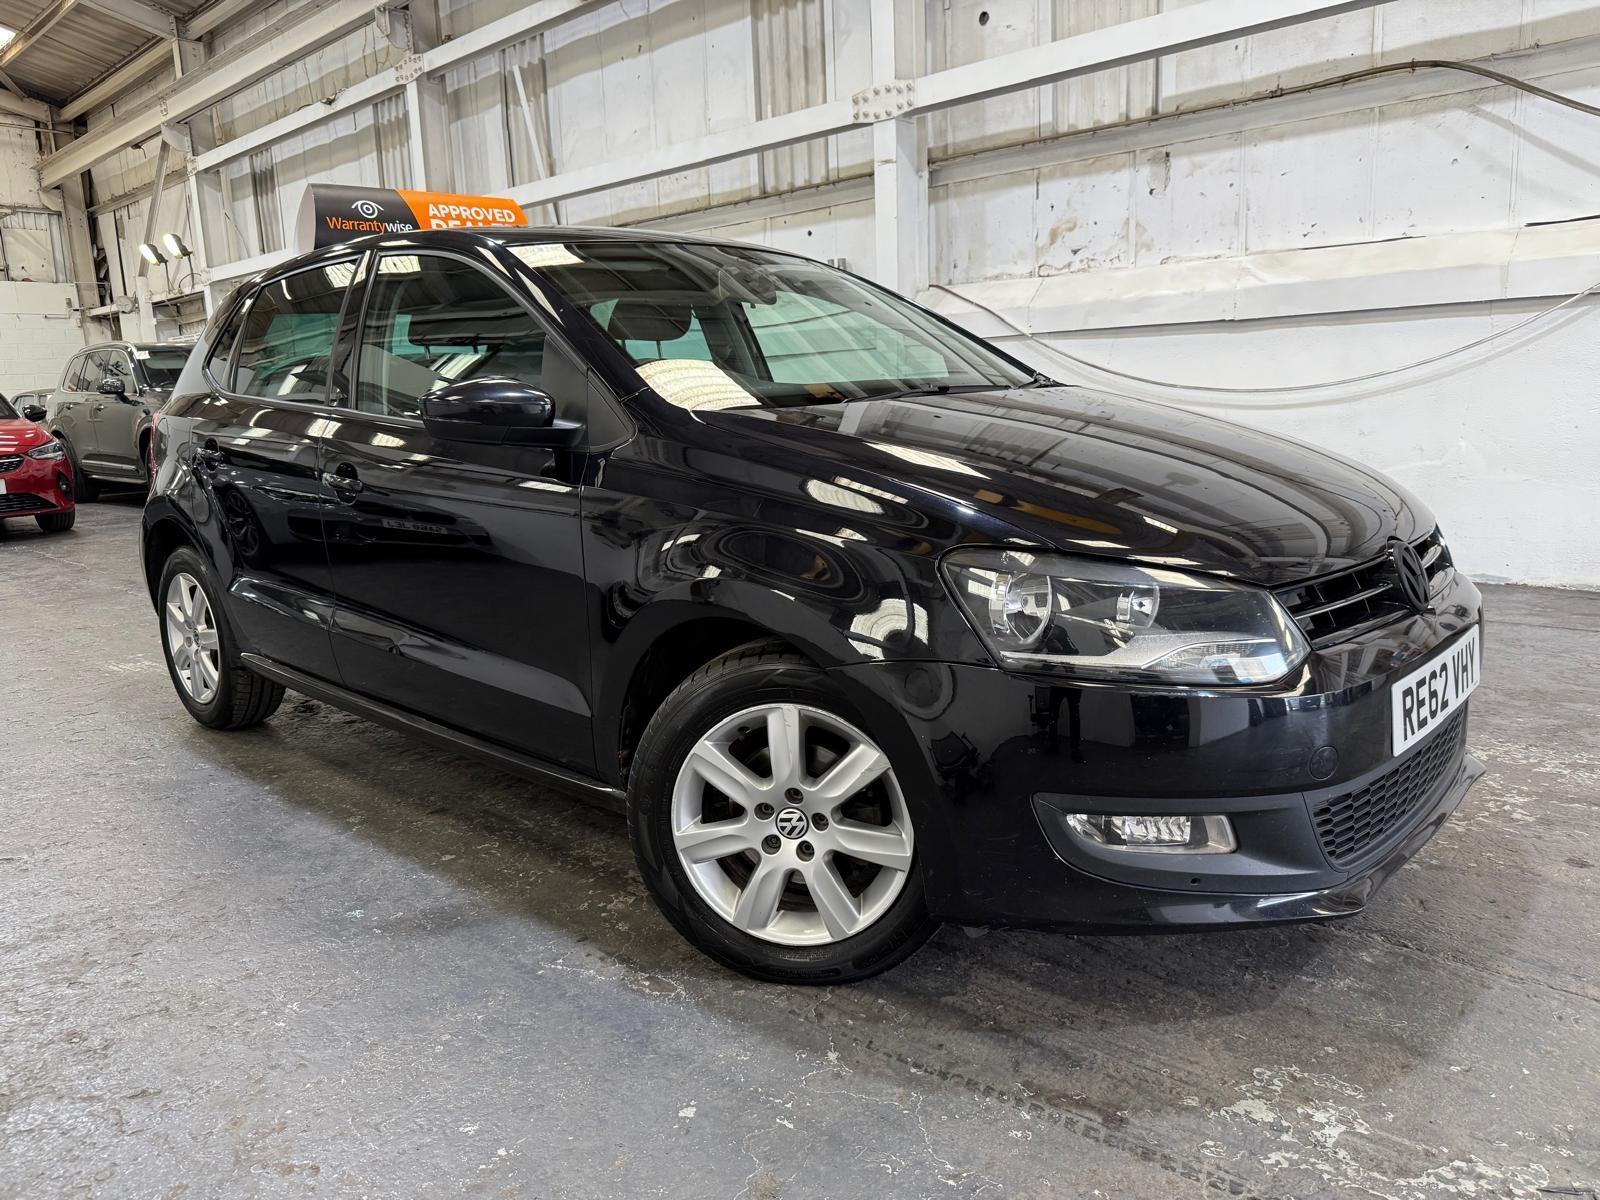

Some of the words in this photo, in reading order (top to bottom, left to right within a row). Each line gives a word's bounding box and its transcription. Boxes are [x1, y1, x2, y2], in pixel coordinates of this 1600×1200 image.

[428, 203, 516, 223] APPROVED
[326, 216, 413, 234] Warrantywise
[1402, 662, 1449, 742] RE62
[1452, 637, 1475, 699] VHY
